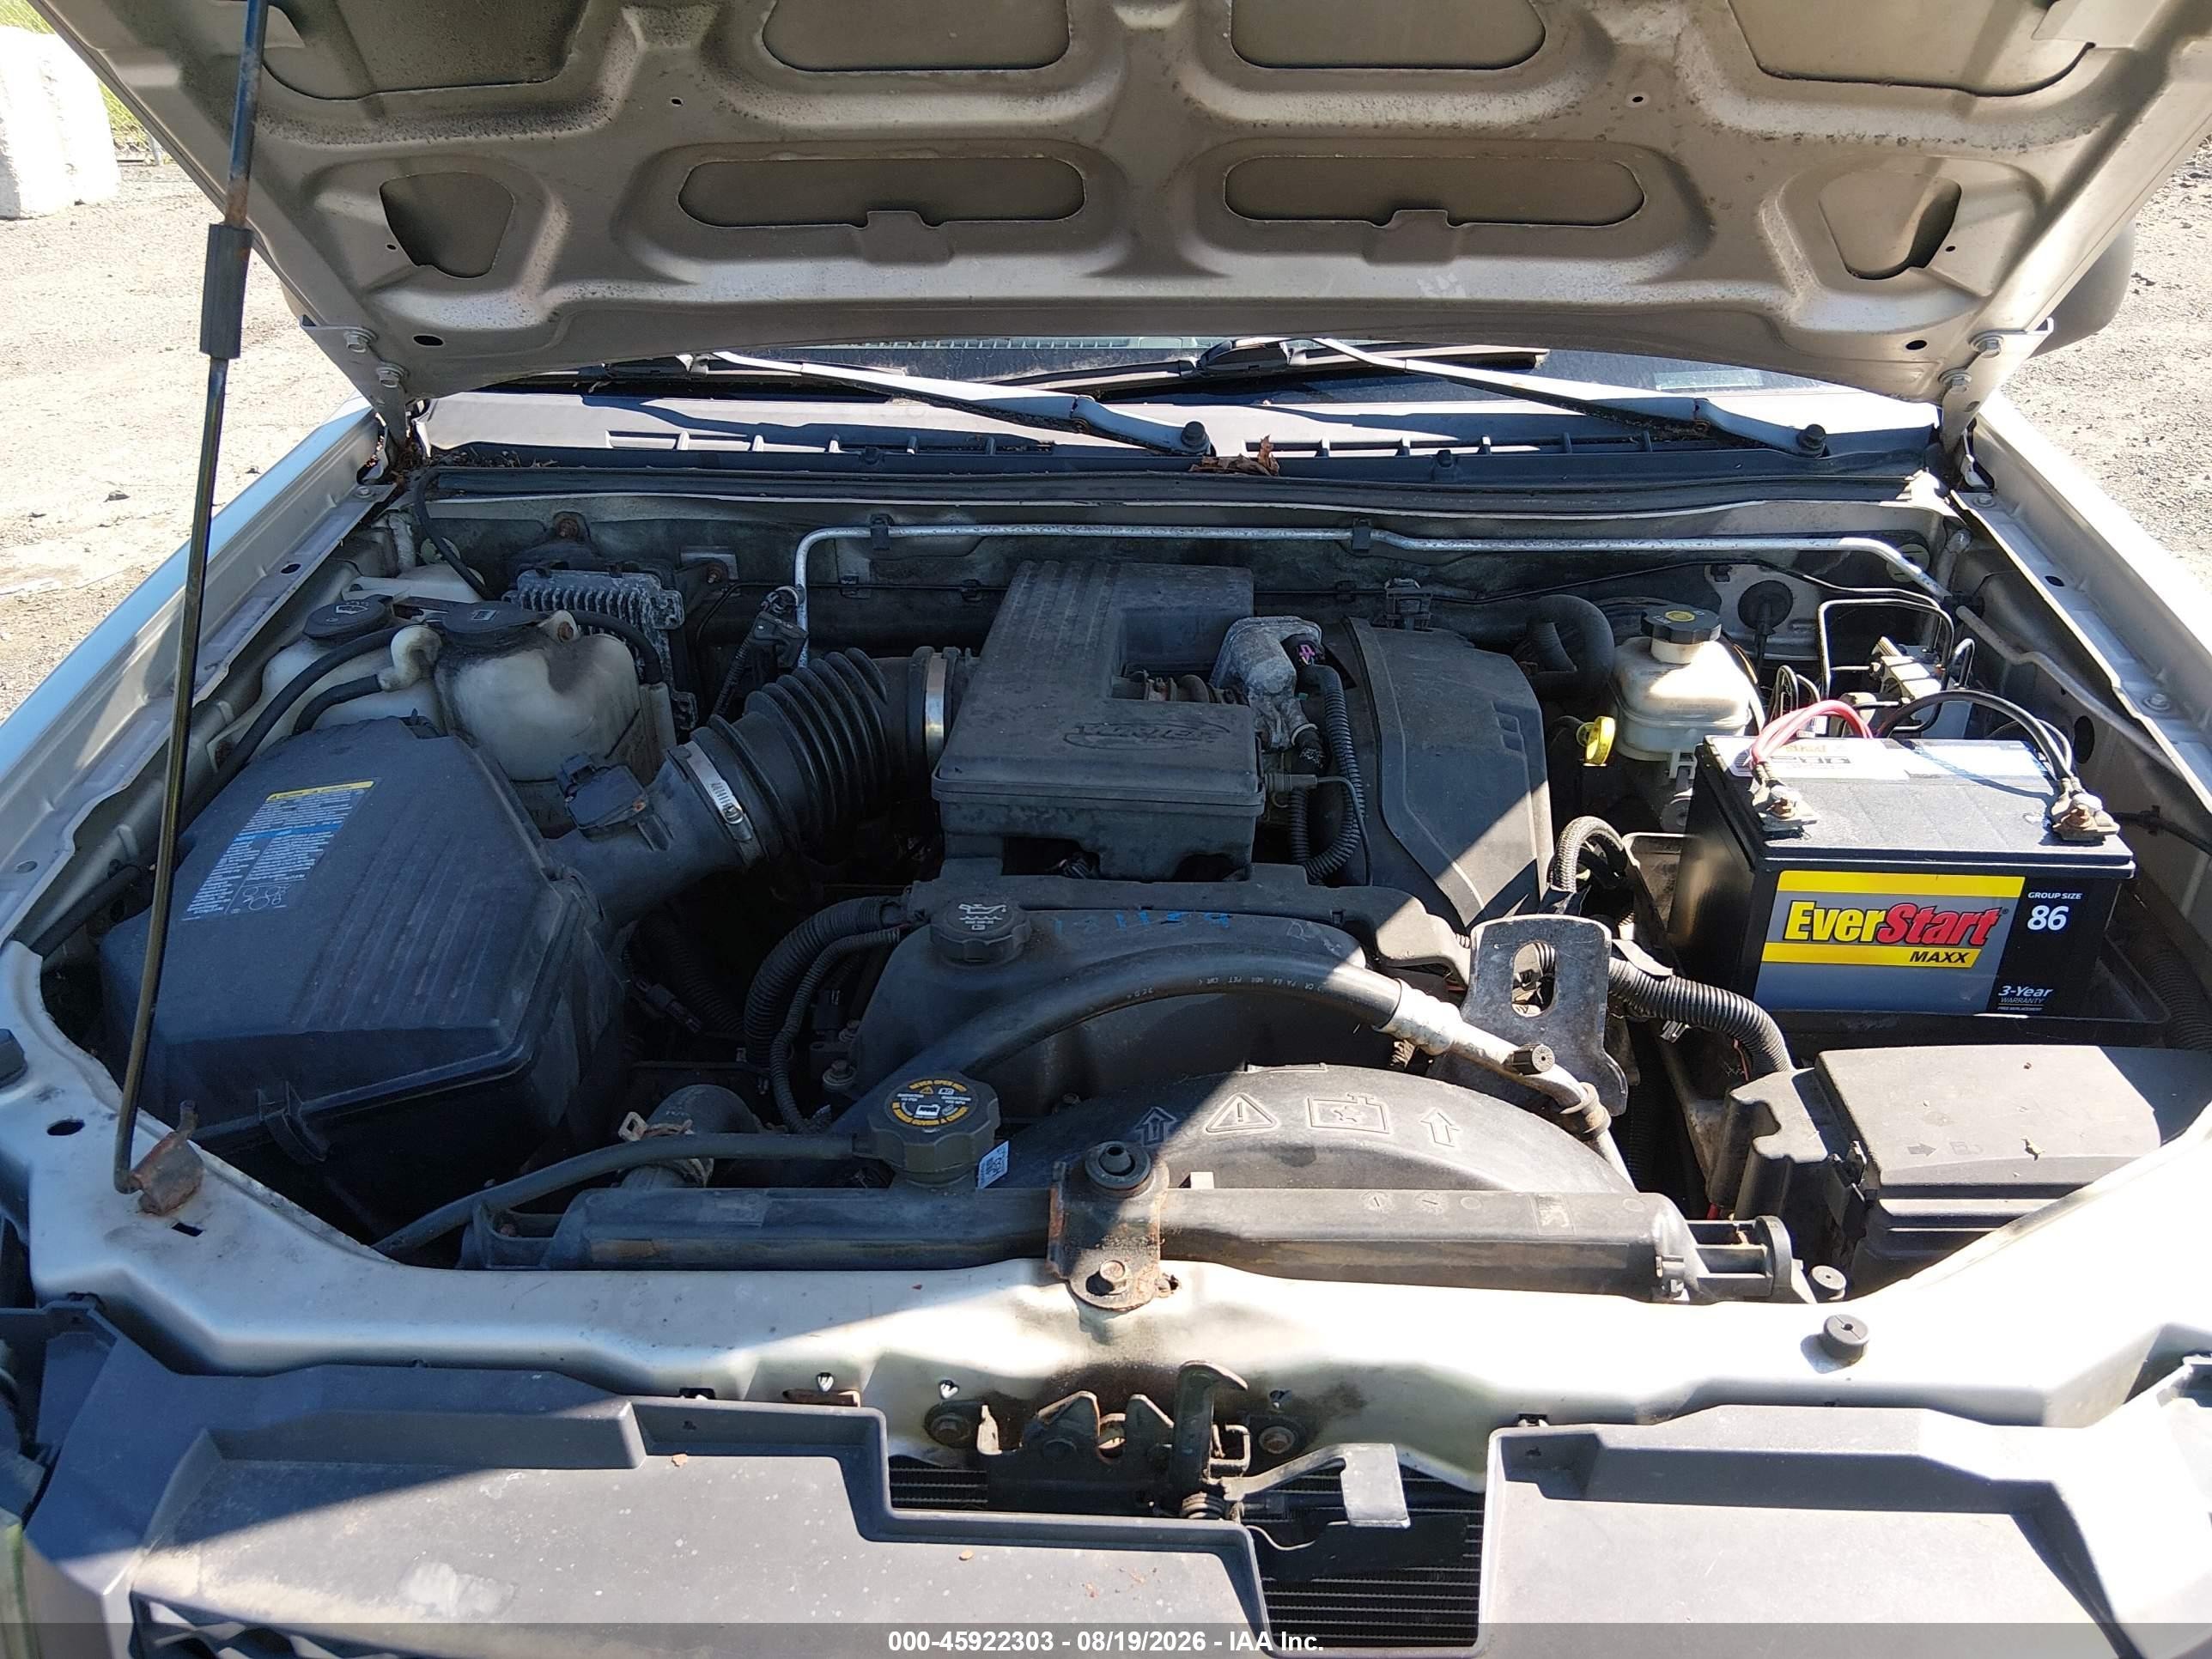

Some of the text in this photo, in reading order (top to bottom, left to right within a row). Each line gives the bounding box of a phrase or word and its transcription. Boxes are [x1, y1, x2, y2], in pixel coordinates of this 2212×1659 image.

[1784, 900, 2002, 946] EverStart
[2027, 904, 2069, 931] 86
[1909, 951, 1969, 963] MAXX
[1998, 985, 2054, 997] 3-Year
